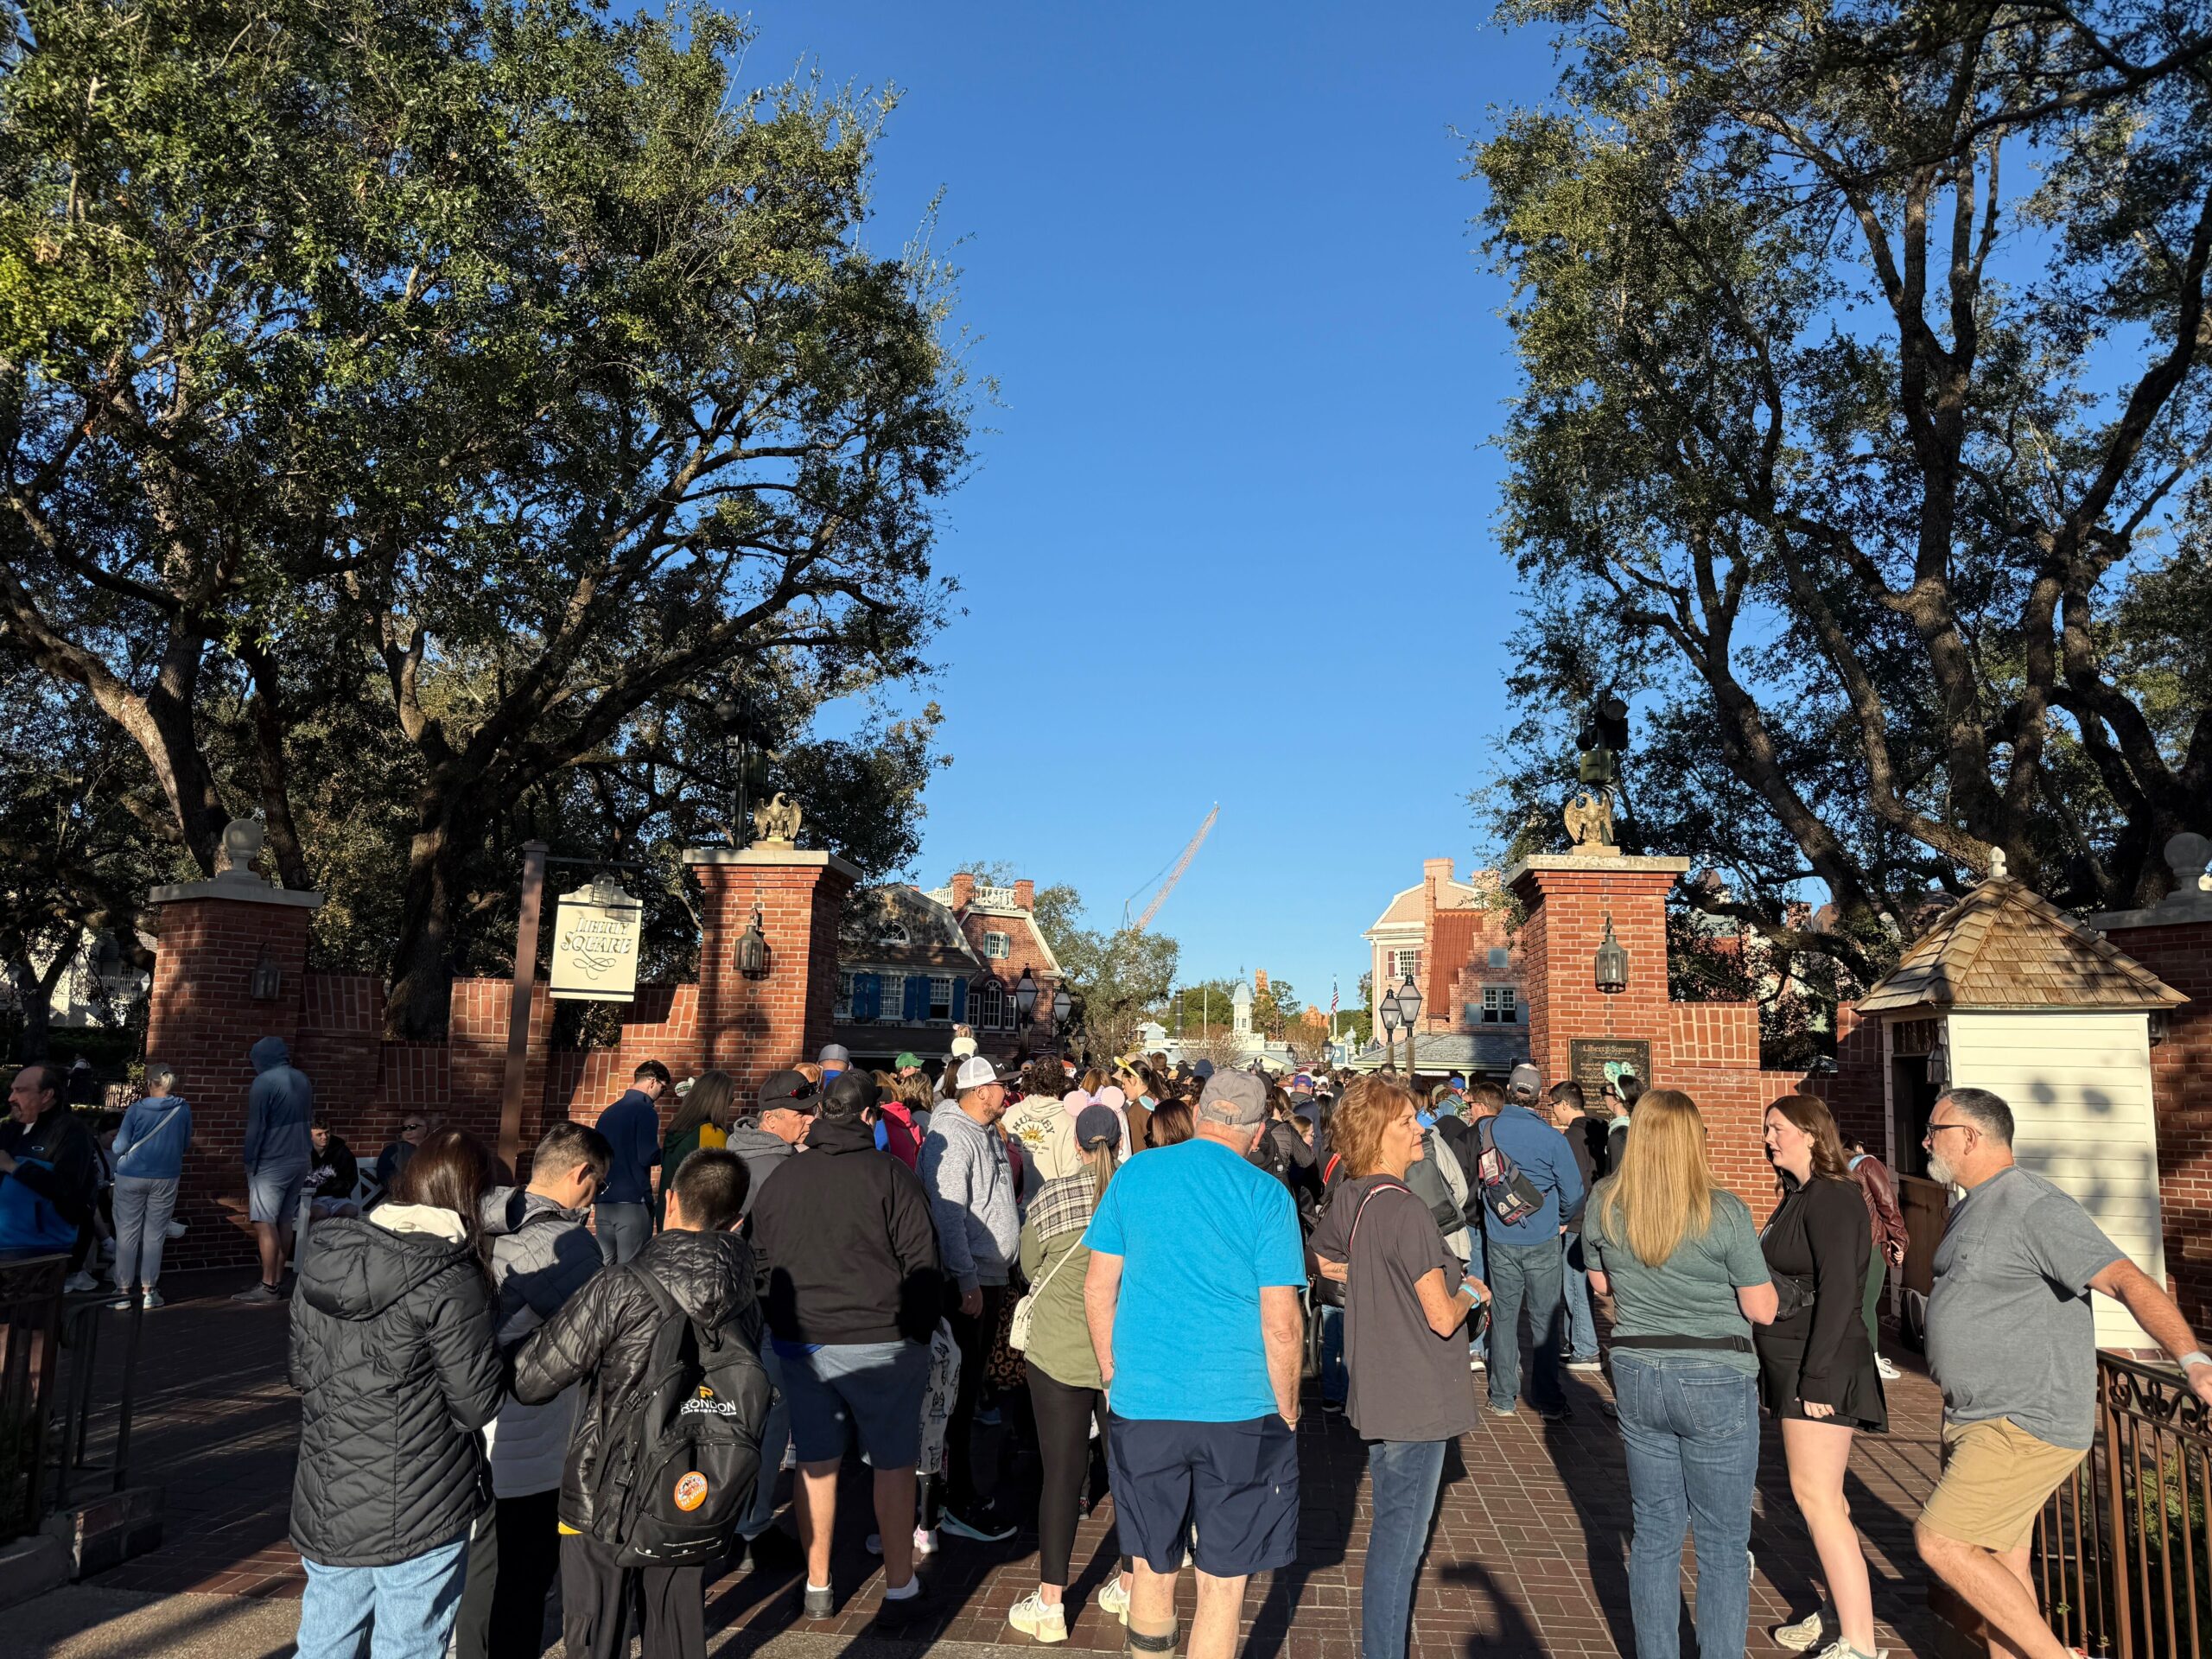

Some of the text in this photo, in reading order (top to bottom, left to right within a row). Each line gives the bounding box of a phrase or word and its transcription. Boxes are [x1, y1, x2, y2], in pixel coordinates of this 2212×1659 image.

[575, 918, 630, 936] LIBERTY
[560, 931, 632, 955] SQUARE
[1582, 1045, 1637, 1054] Liberty Square
[1013, 1116, 1055, 1134] HUEY
